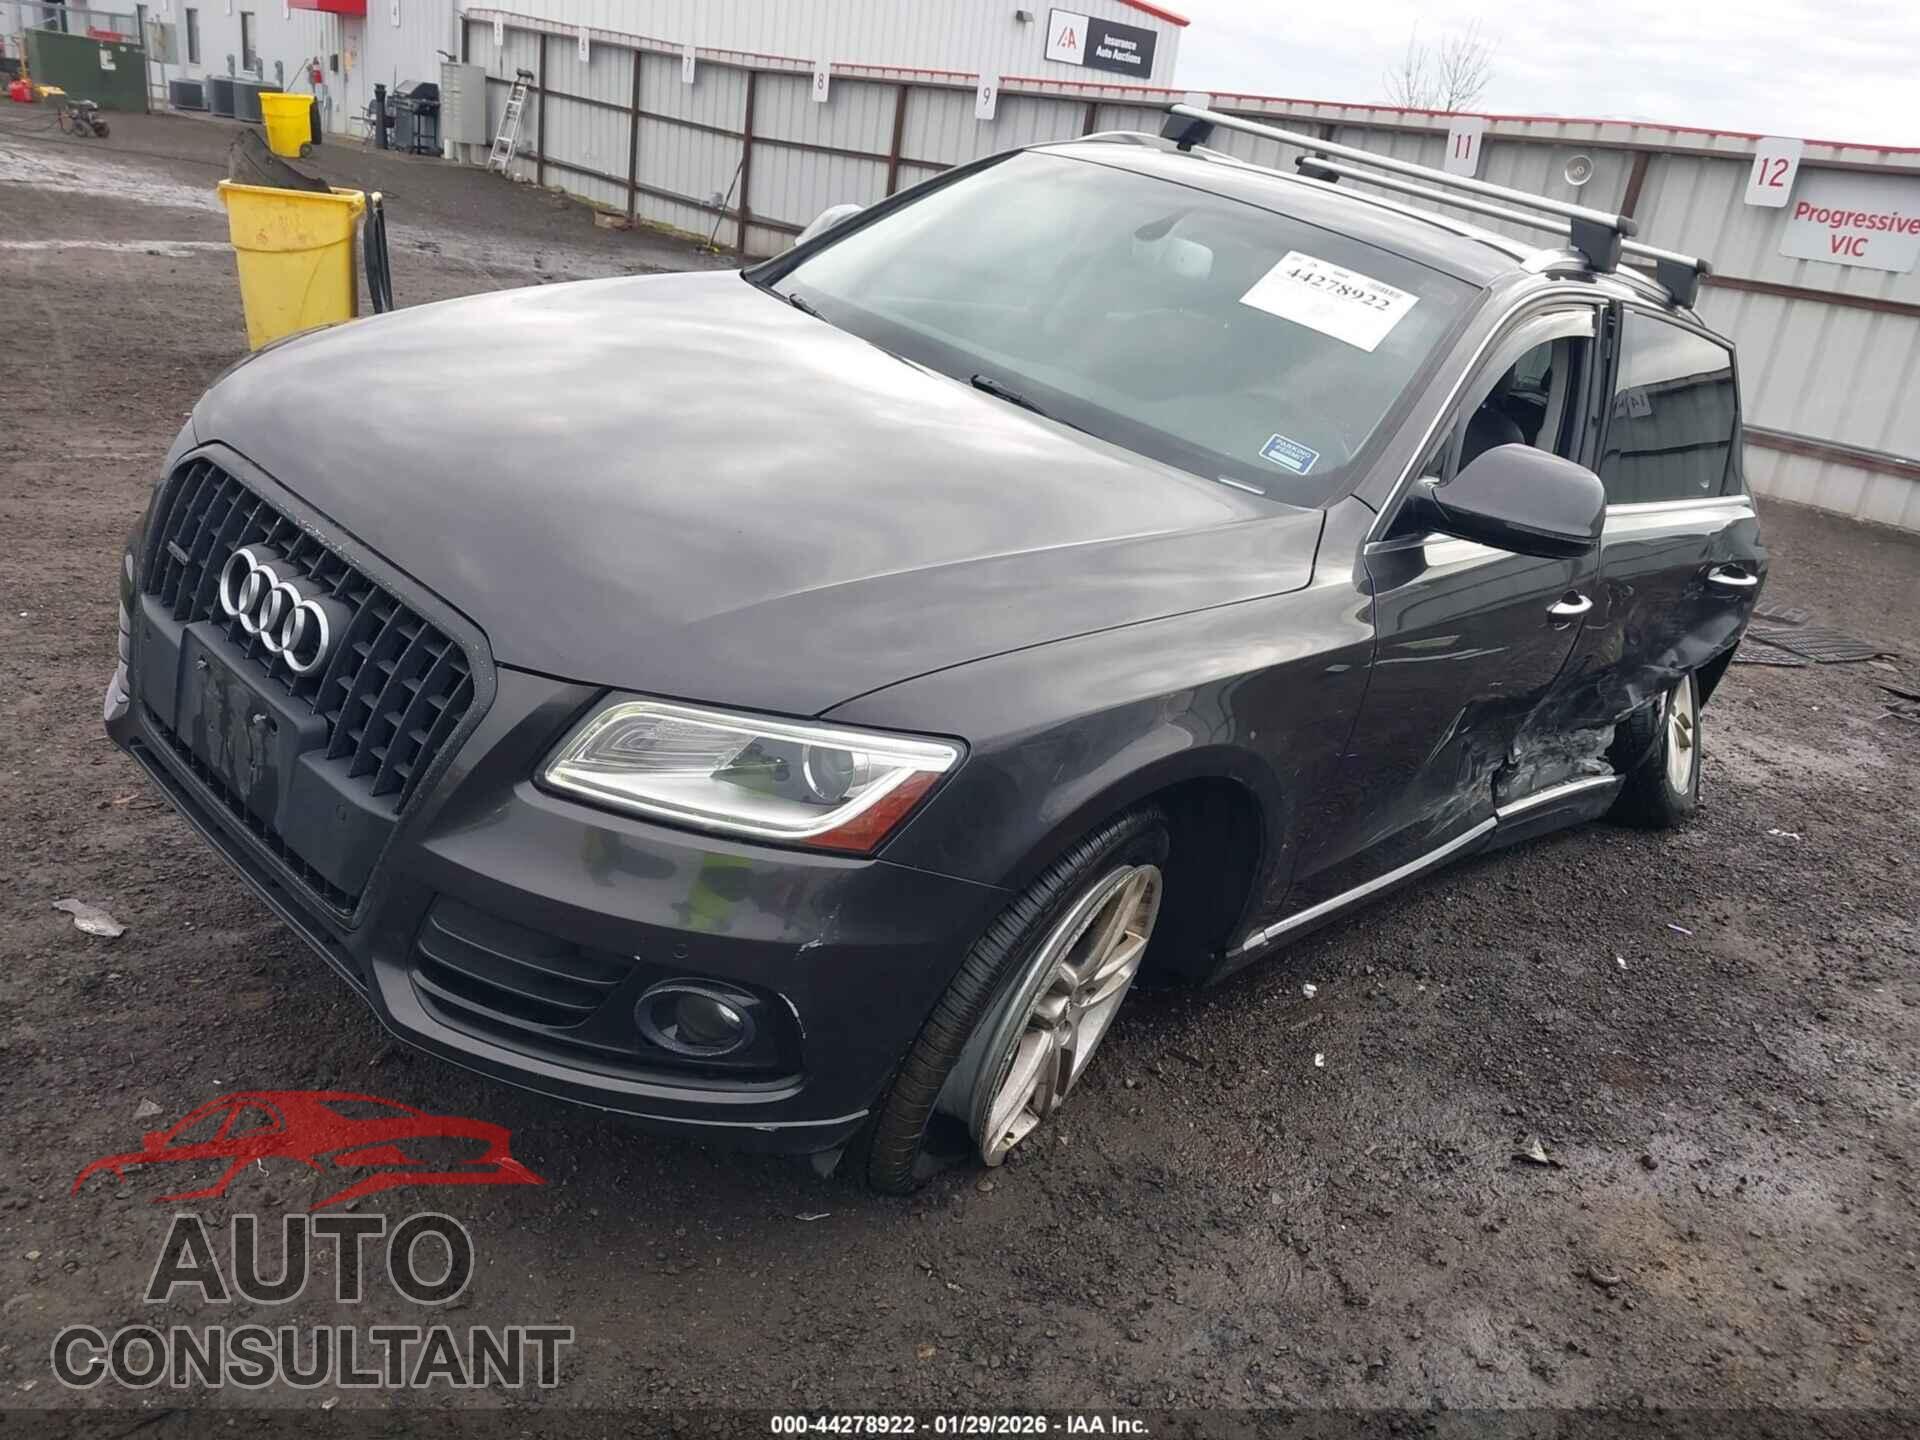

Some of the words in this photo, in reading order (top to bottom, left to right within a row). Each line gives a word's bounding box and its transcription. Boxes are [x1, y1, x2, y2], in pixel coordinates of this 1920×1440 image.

[1096, 45, 1113, 59] Auto
[686, 57, 692, 72] 7
[816, 73, 825, 90] 8
[983, 87, 991, 105] 9
[1455, 134, 1473, 159] 11
[1757, 158, 1789, 187] 12
[1793, 202, 1920, 235] Progressive
[1830, 234, 1869, 257] VIC
[1286, 268, 1391, 312] 44278922
